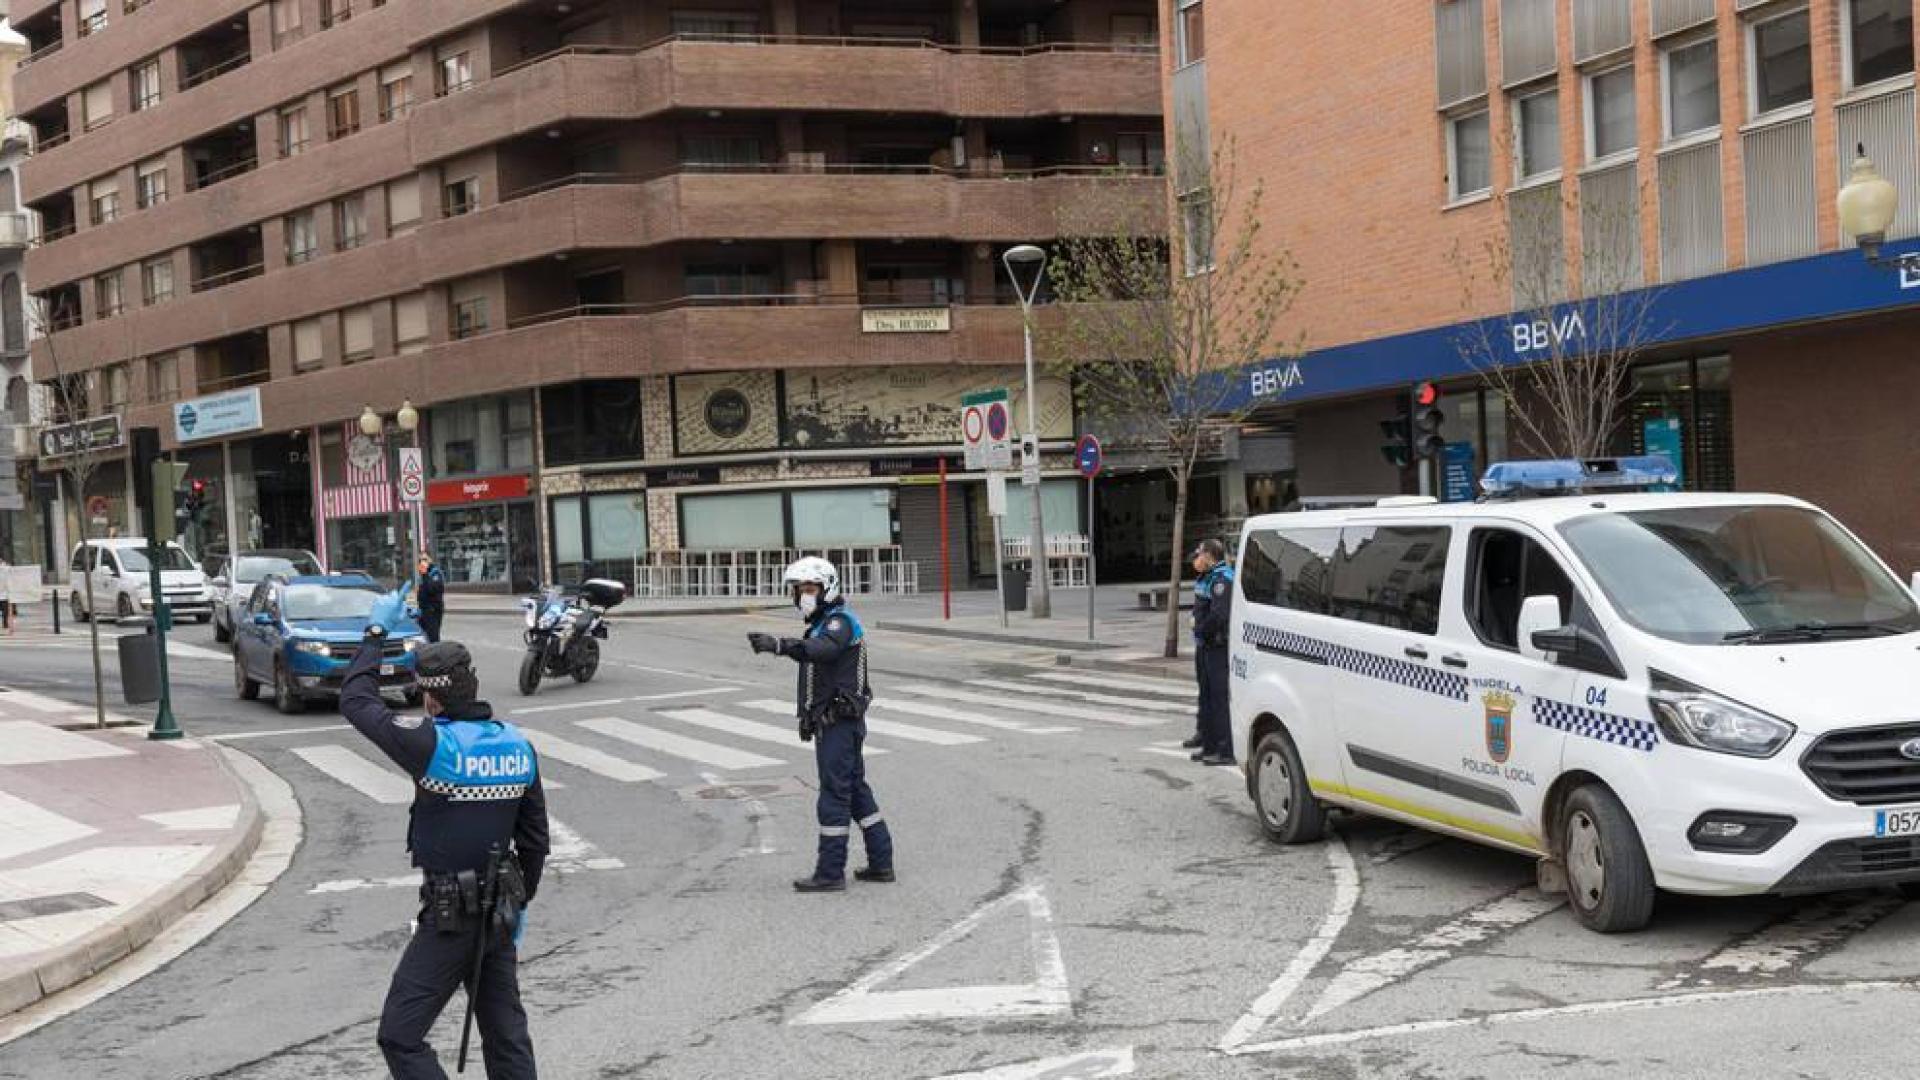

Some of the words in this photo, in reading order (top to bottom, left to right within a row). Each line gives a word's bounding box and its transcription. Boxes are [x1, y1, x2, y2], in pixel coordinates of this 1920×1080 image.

[1513, 309, 1586, 353] BBVA
[1251, 361, 1304, 397] BBVA
[1472, 678, 1523, 696] TUDELA
[1585, 686, 1607, 707] 04
[1504, 768, 1537, 785] LOCAL
